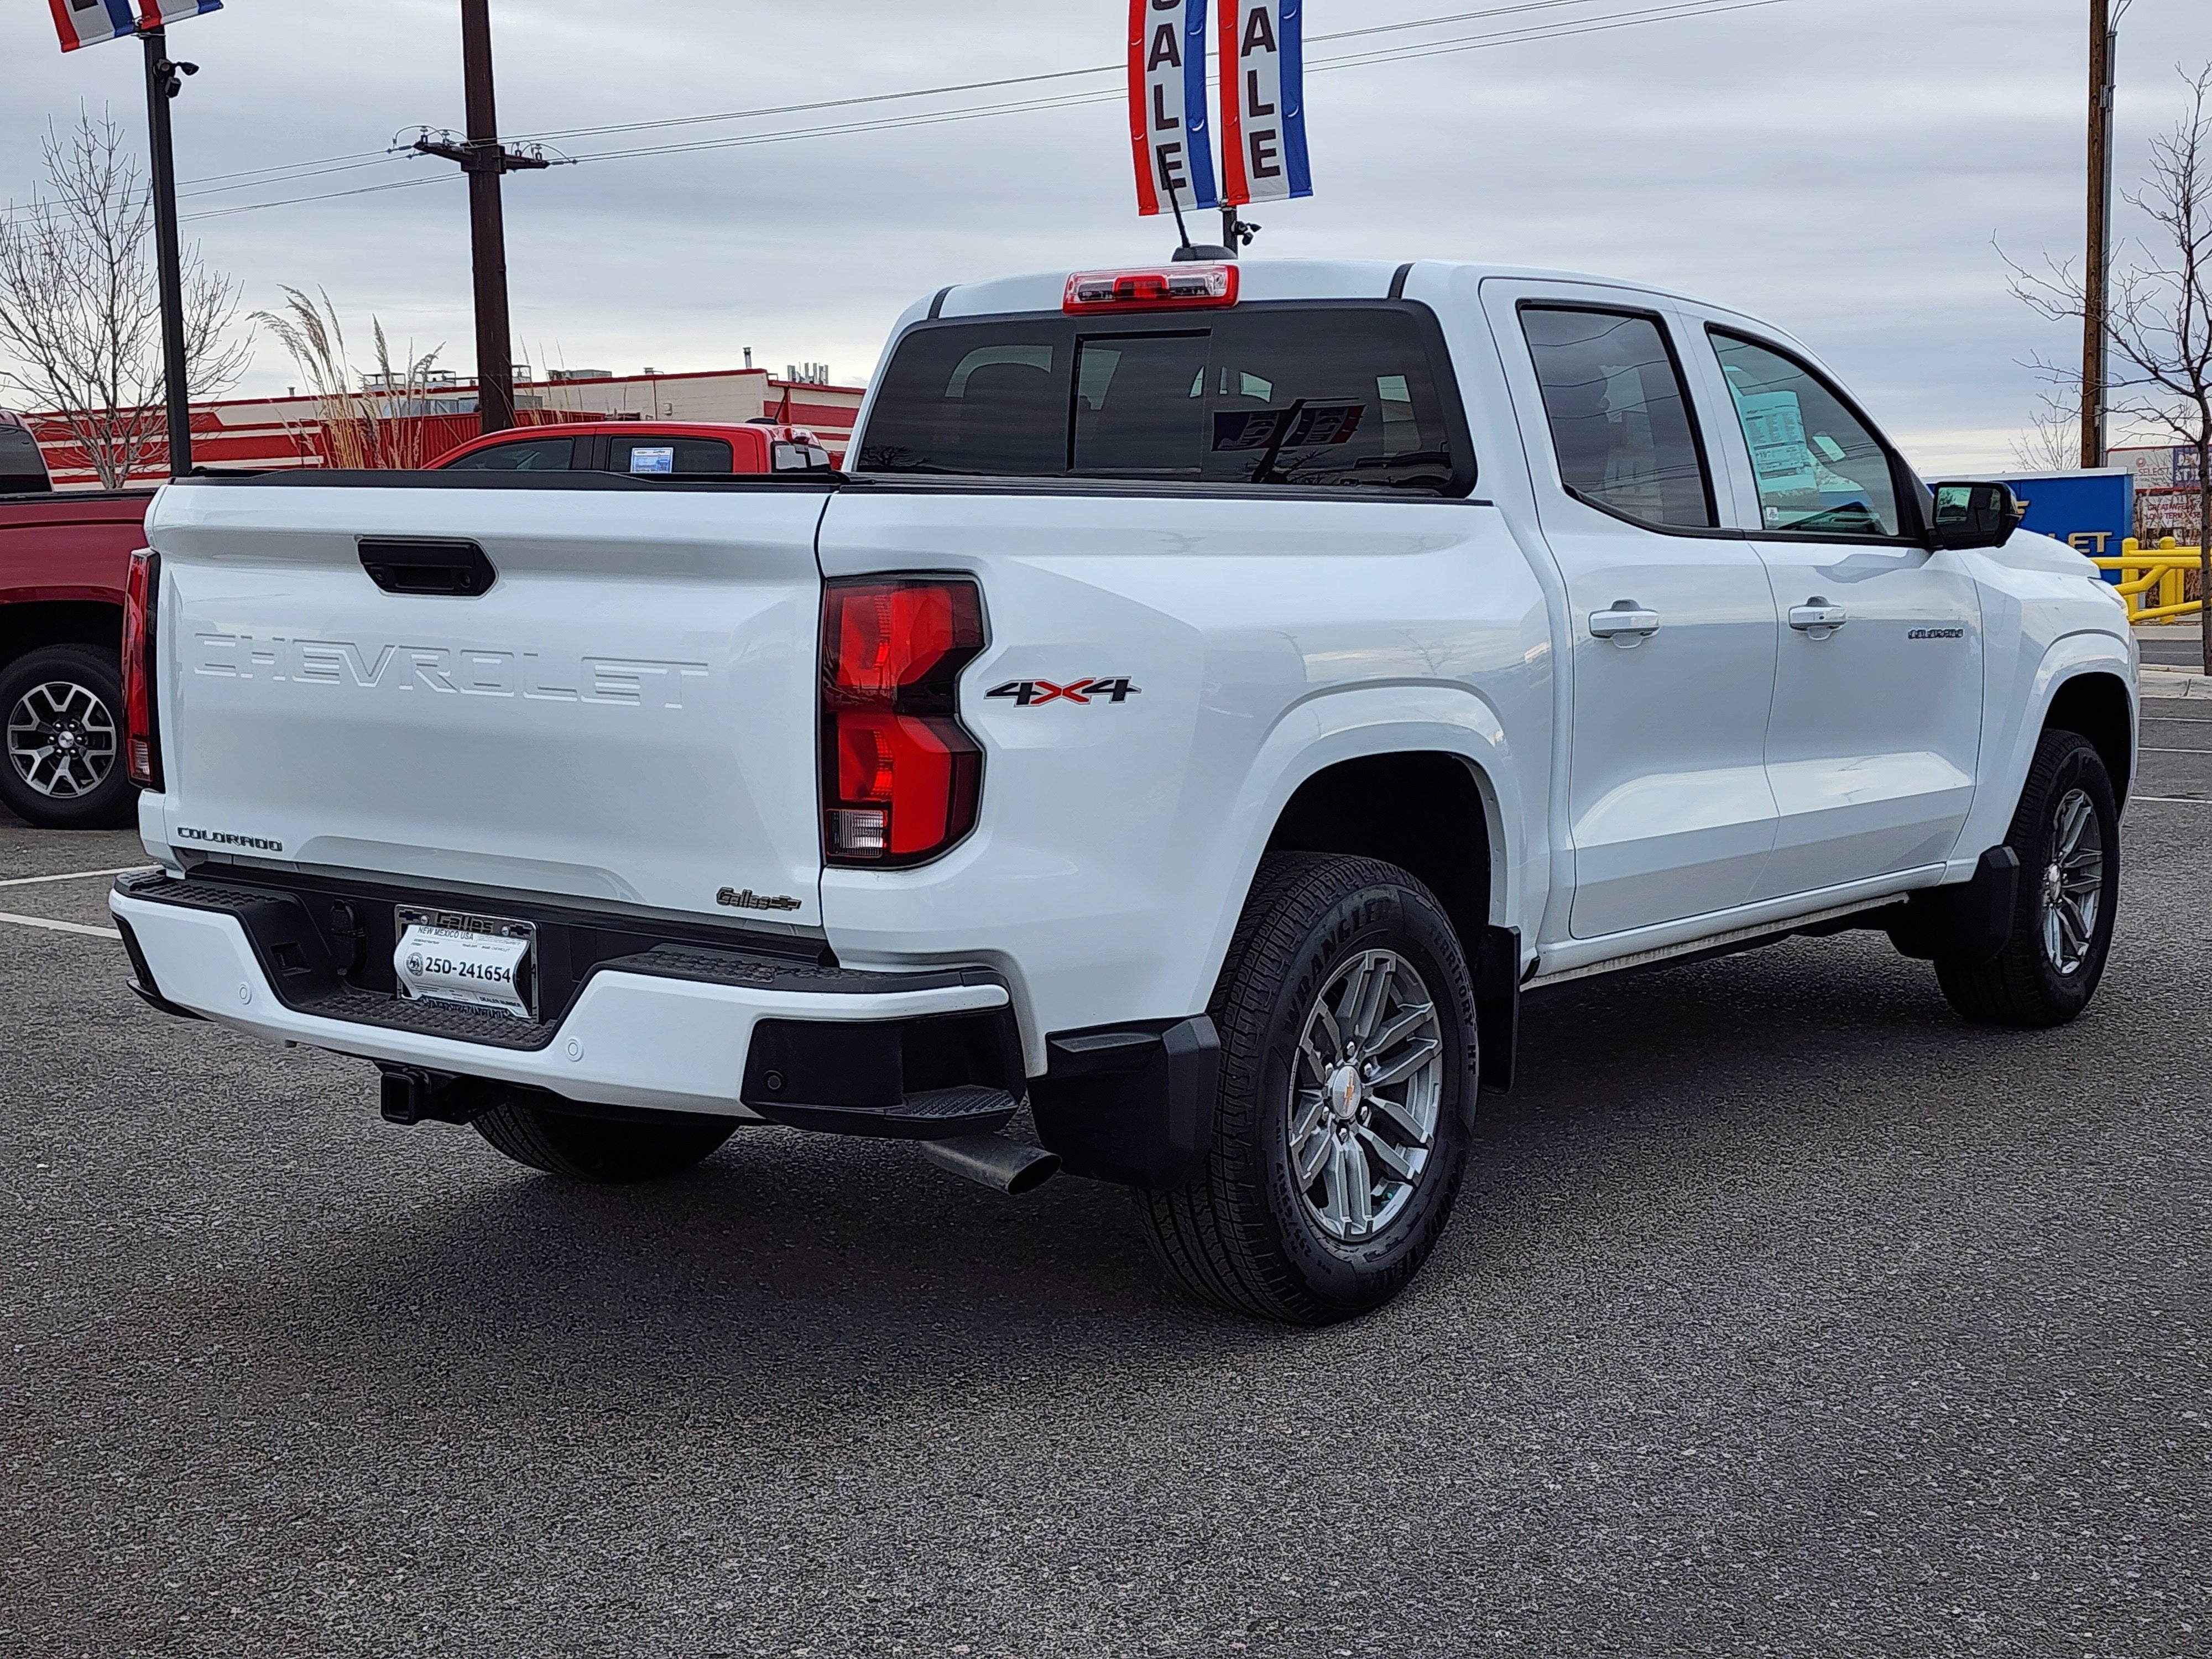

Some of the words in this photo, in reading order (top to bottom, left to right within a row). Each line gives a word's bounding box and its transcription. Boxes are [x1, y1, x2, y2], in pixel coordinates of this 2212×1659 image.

[1147, 0, 1187, 191] ALE
[195, 633, 708, 708] CHEVROLET
[177, 827, 283, 851] COLORADO
[717, 886, 770, 910] Galles
[418, 926, 434, 935] NEW
[435, 928, 458, 938] MEXICO
[460, 932, 473, 940] USA
[425, 957, 511, 983] 25D-241654
